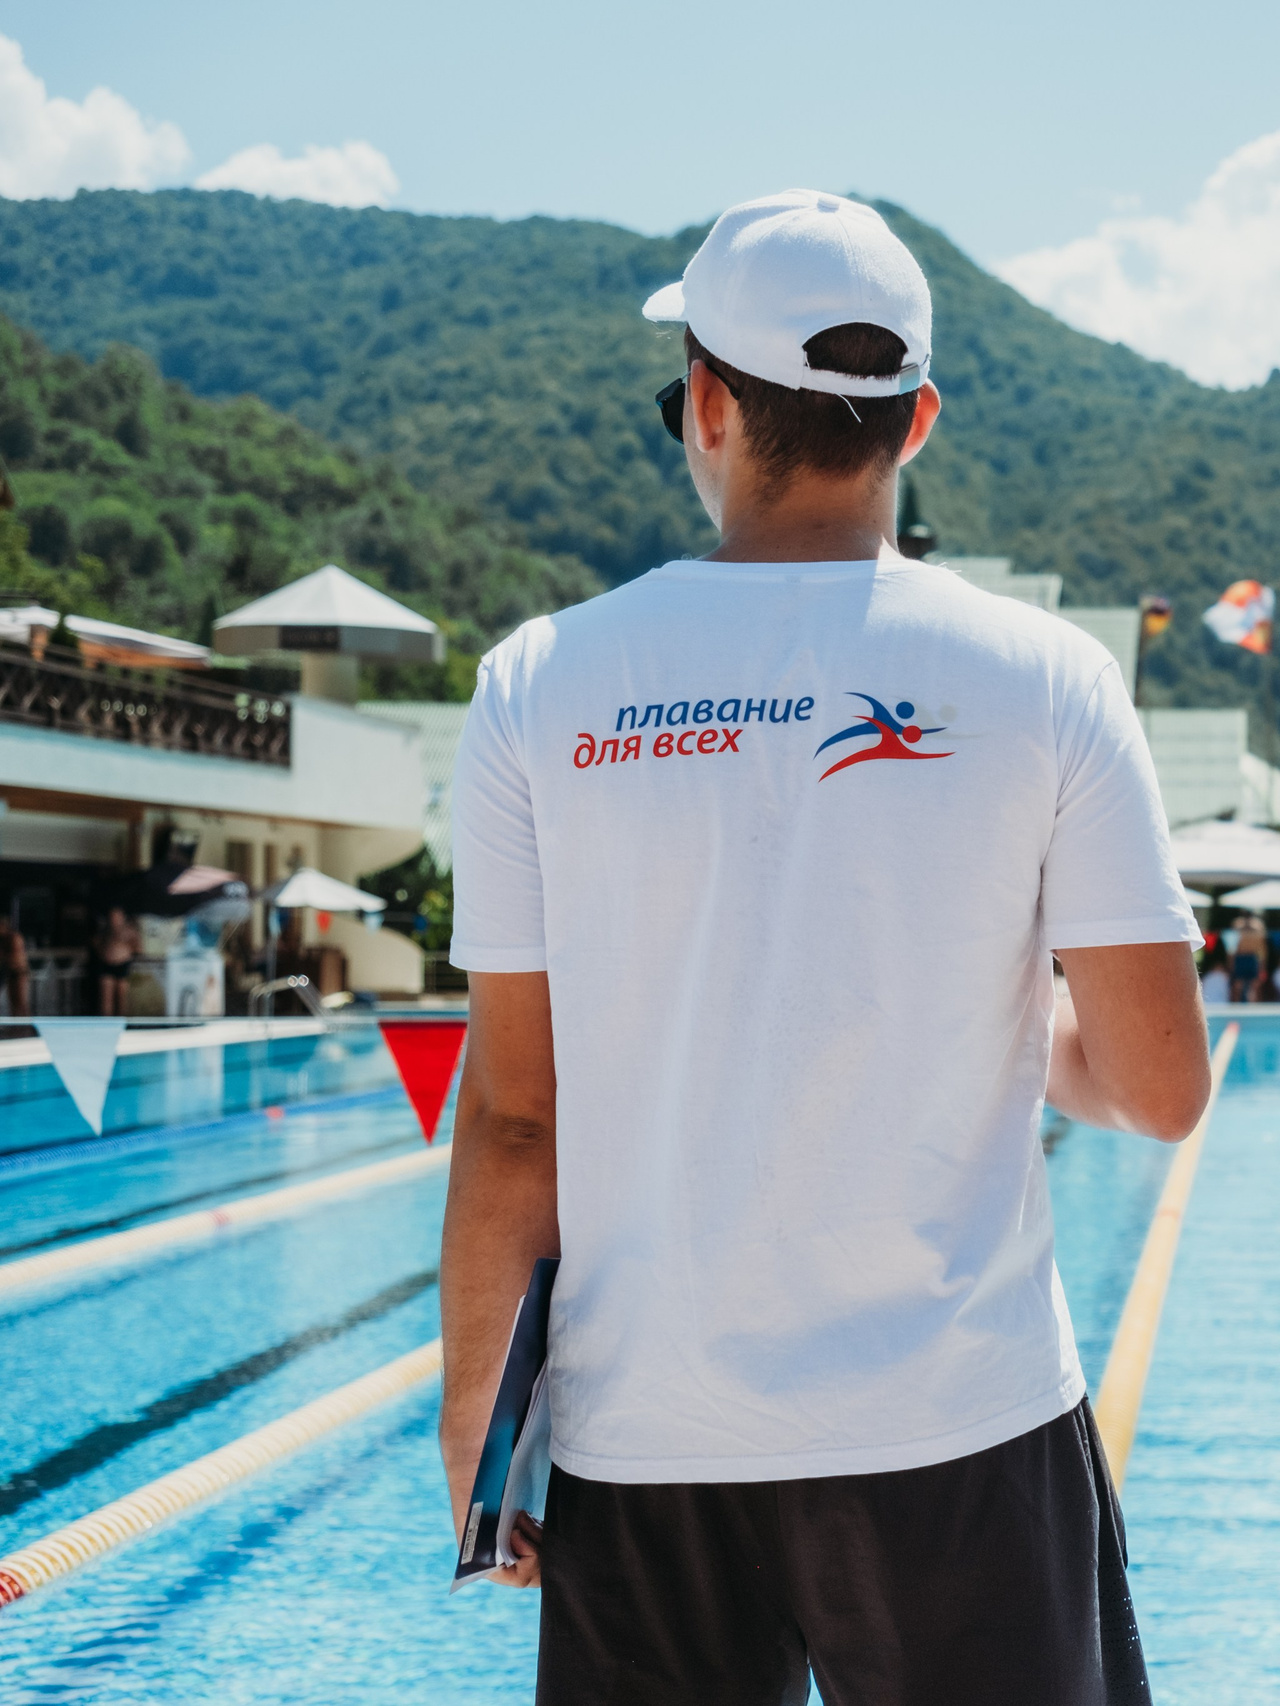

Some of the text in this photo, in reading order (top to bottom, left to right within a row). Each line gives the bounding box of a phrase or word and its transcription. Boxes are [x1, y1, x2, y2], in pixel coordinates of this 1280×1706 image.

[615, 696, 815, 732] плавание
[573, 728, 744, 769] для всех
